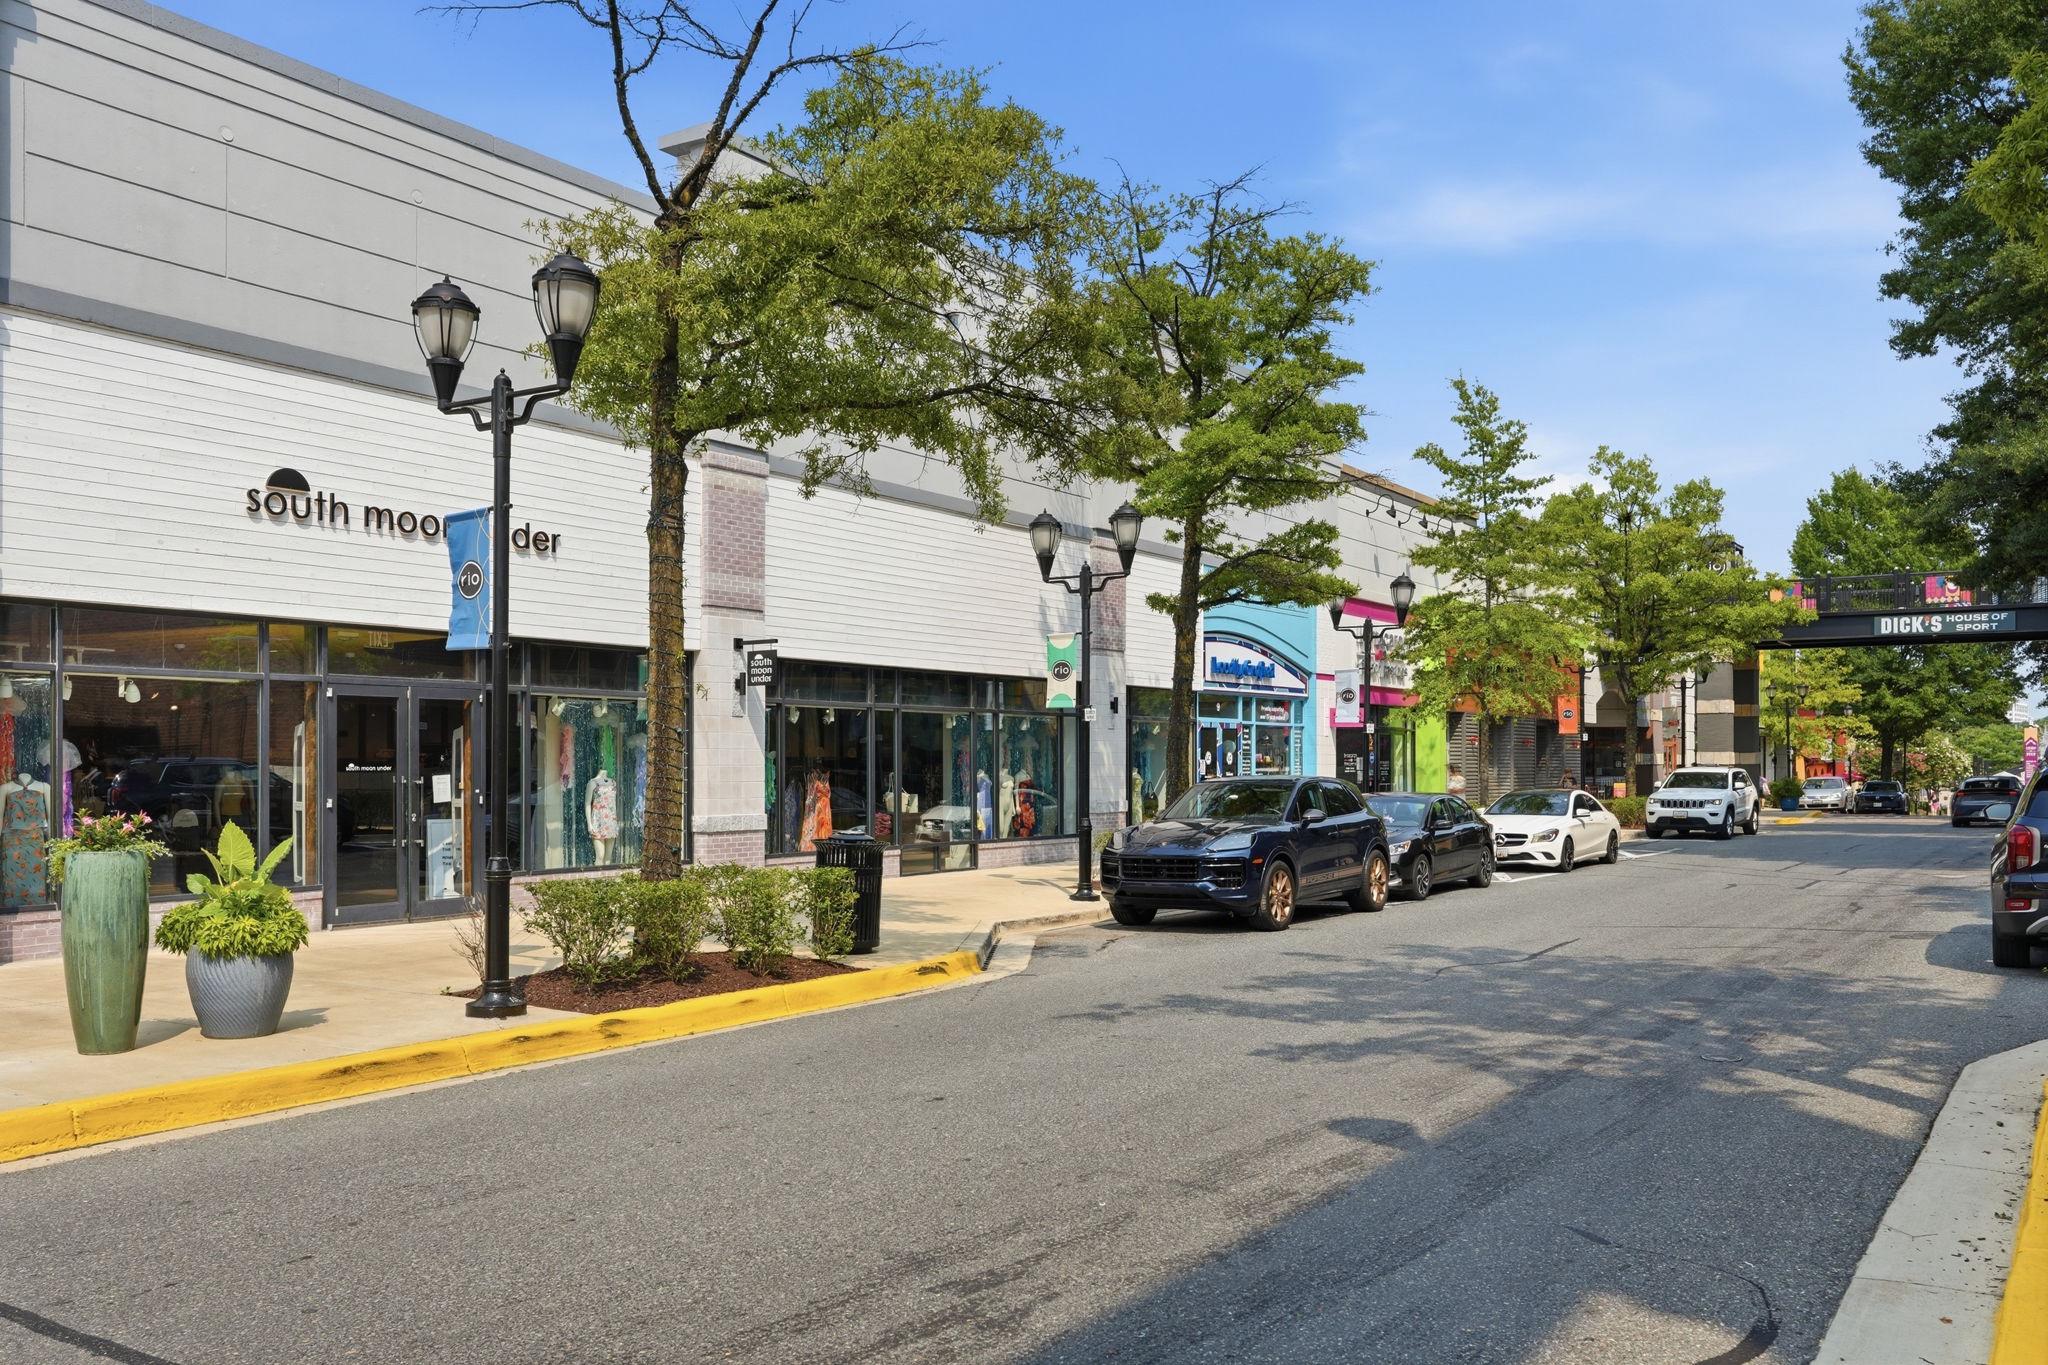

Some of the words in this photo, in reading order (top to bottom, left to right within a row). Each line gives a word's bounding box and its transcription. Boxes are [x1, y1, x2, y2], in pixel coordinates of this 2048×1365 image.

[246, 489, 349, 525] south
[364, 505, 447, 538] moo
[461, 571, 480, 587] rio
[1946, 613, 1988, 622] HOUSE
[1991, 612, 2008, 620] OF
[1880, 614, 1942, 634] DICK'S
[1955, 622, 1998, 631] SPORT
[750, 658, 772, 667] south
[750, 667, 772, 675] moon
[1055, 666, 1069, 674] rio
[750, 675, 772, 683] under
